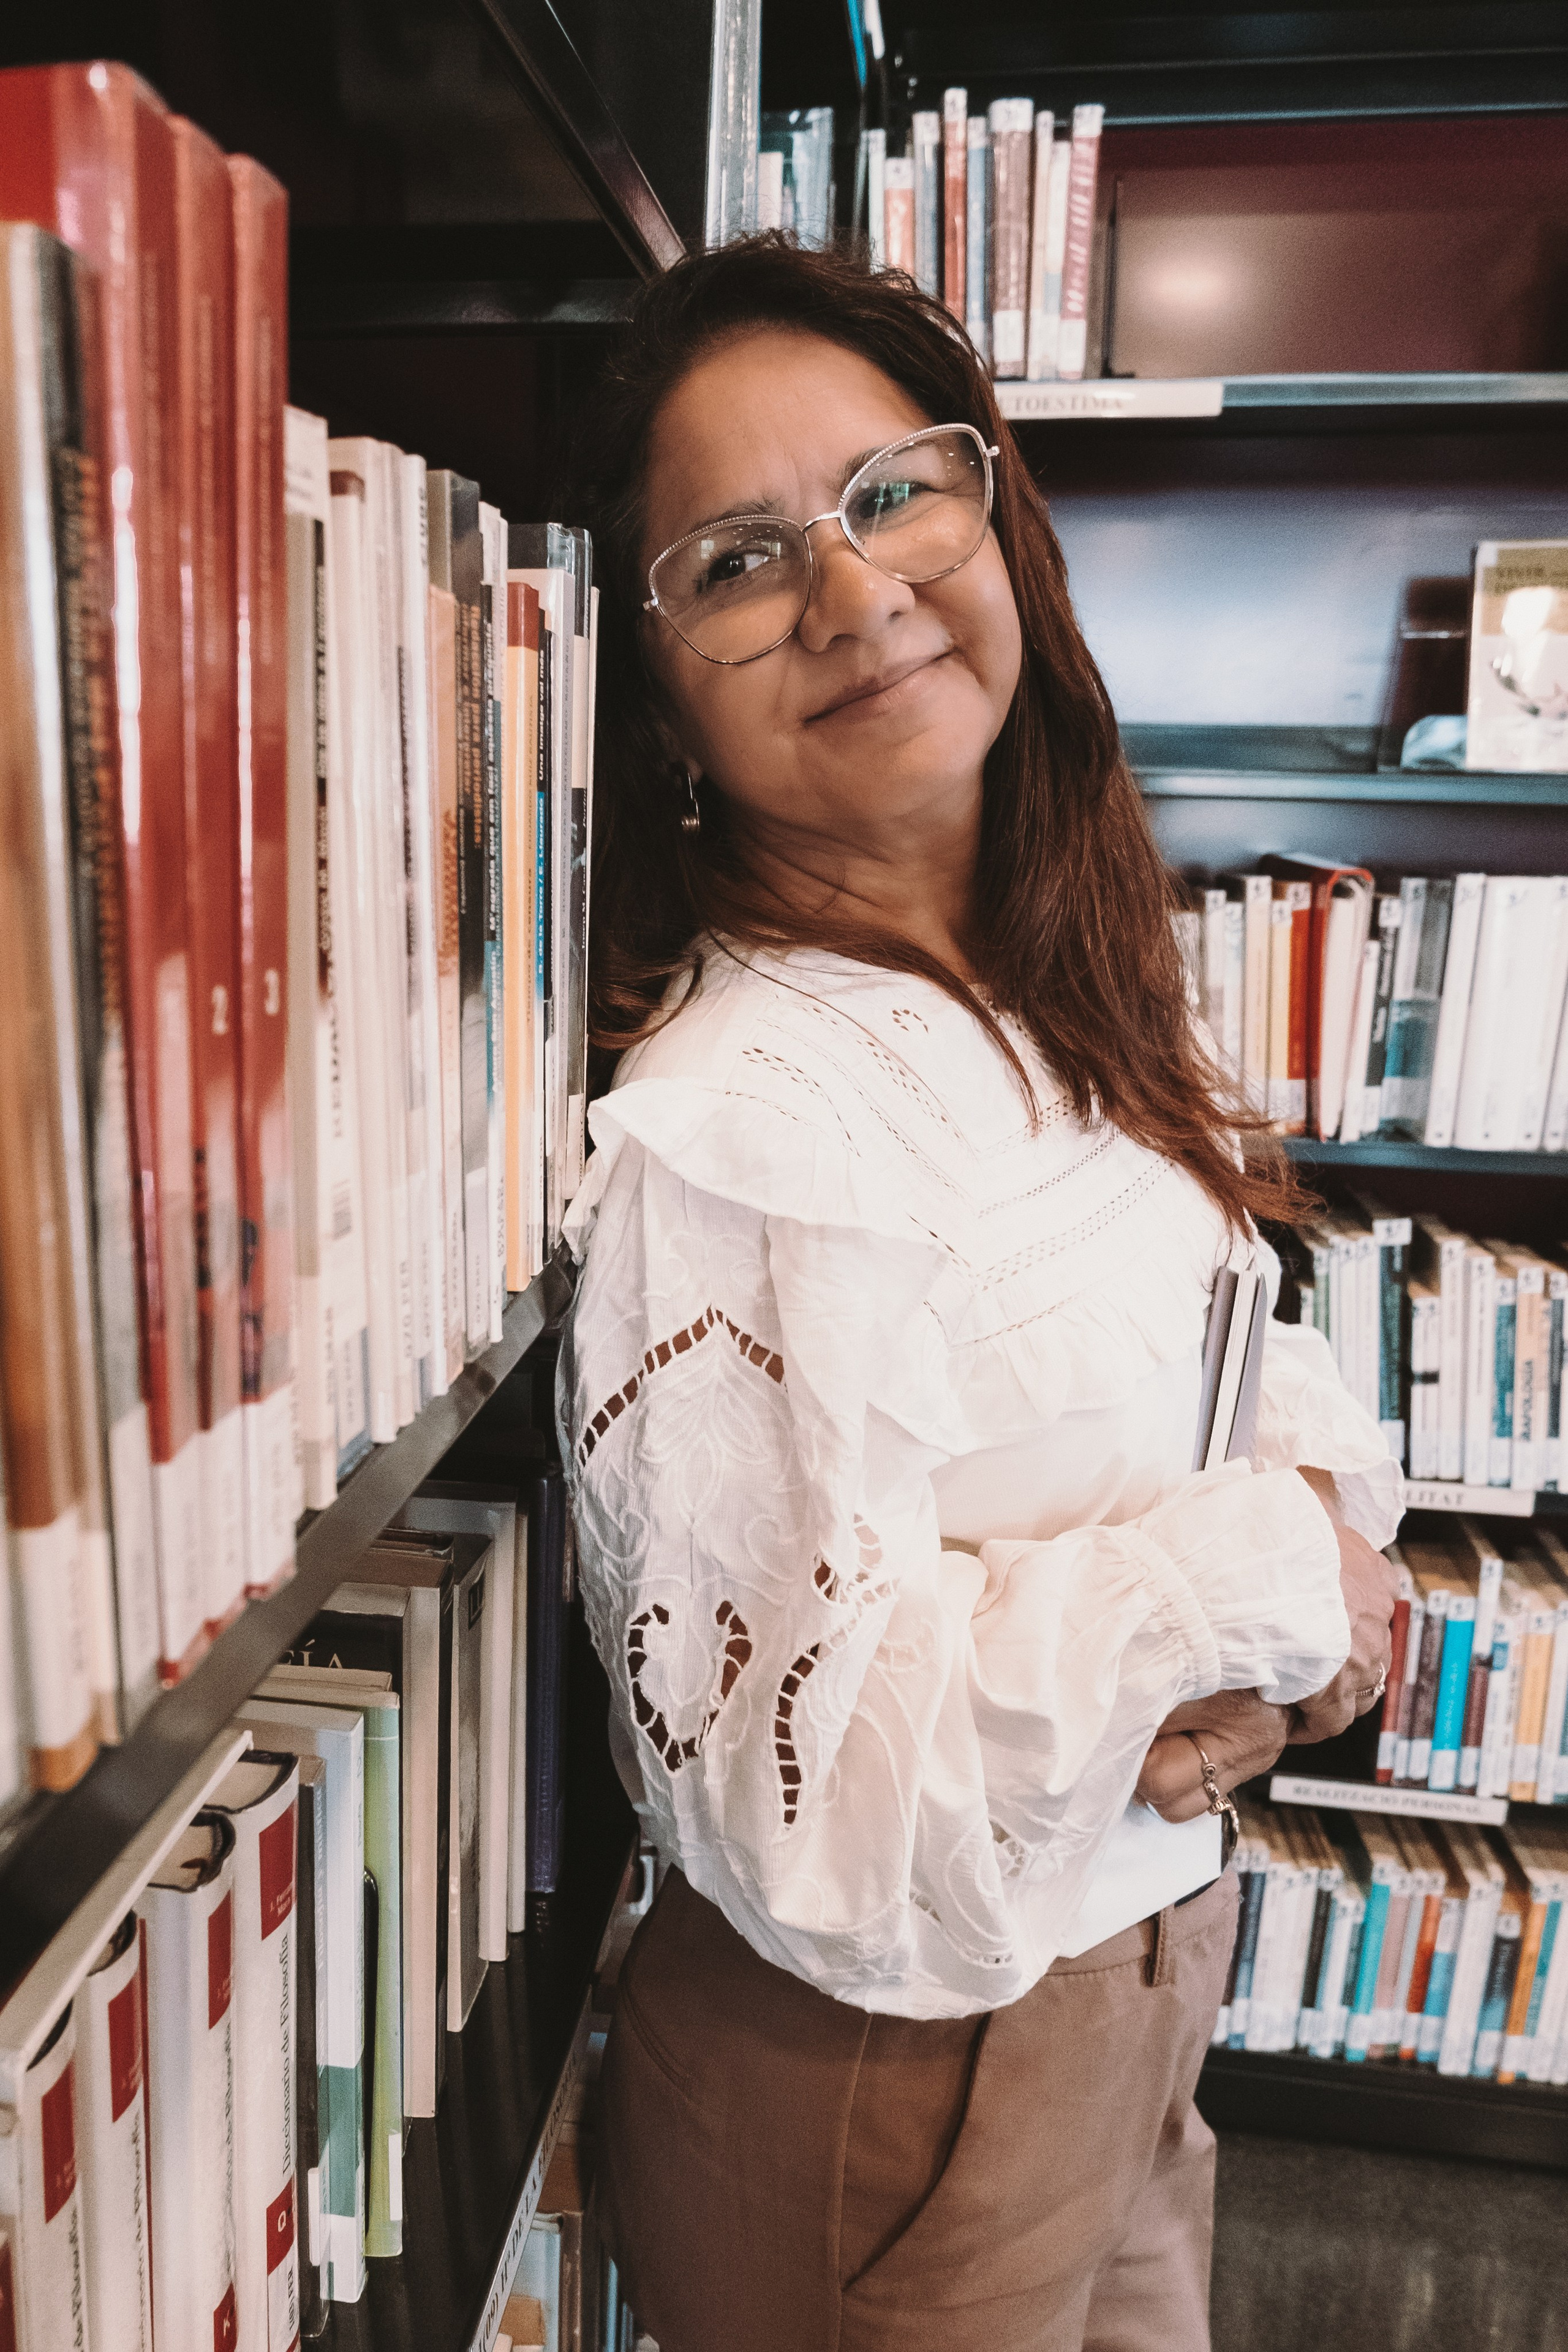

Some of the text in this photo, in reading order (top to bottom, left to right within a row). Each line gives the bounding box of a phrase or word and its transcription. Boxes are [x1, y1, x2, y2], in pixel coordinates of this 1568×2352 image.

[489, 799, 495, 823] em
[279, 1933, 292, 2175] Diccionario de Filosofía
[277, 2209, 287, 2233] Q
